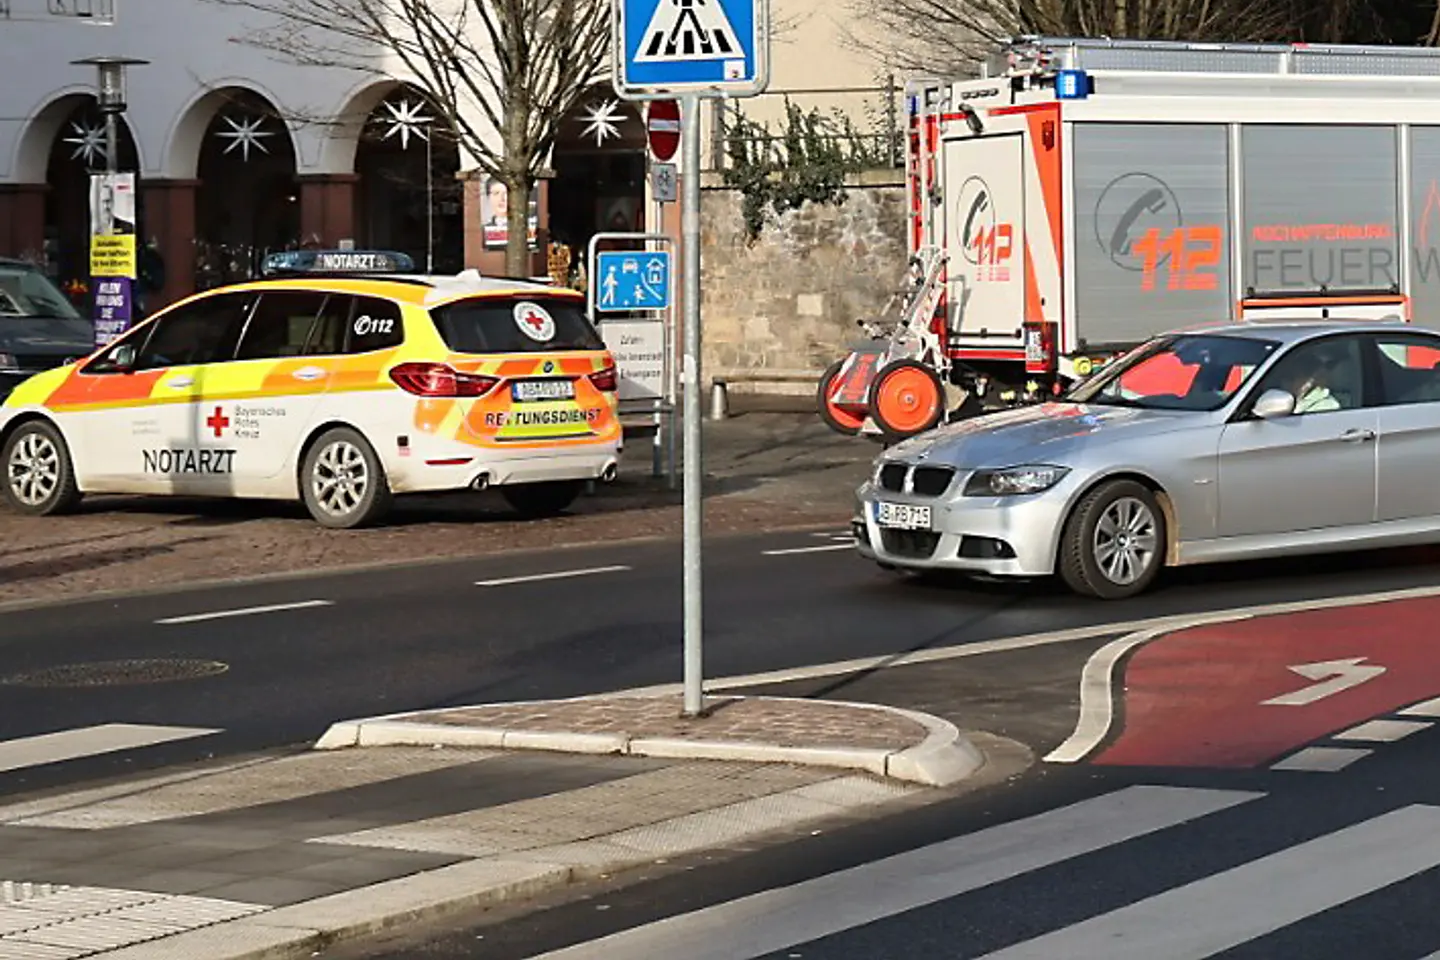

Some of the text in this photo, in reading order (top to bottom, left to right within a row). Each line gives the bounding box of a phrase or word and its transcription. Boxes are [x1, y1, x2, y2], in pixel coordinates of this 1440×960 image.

[323, 253, 376, 269] NOTARZT
[971, 223, 1013, 282] 112
[1131, 224, 1222, 291] 112
[370, 318, 394, 334] 112
[142, 449, 237, 474] NOTARZT
